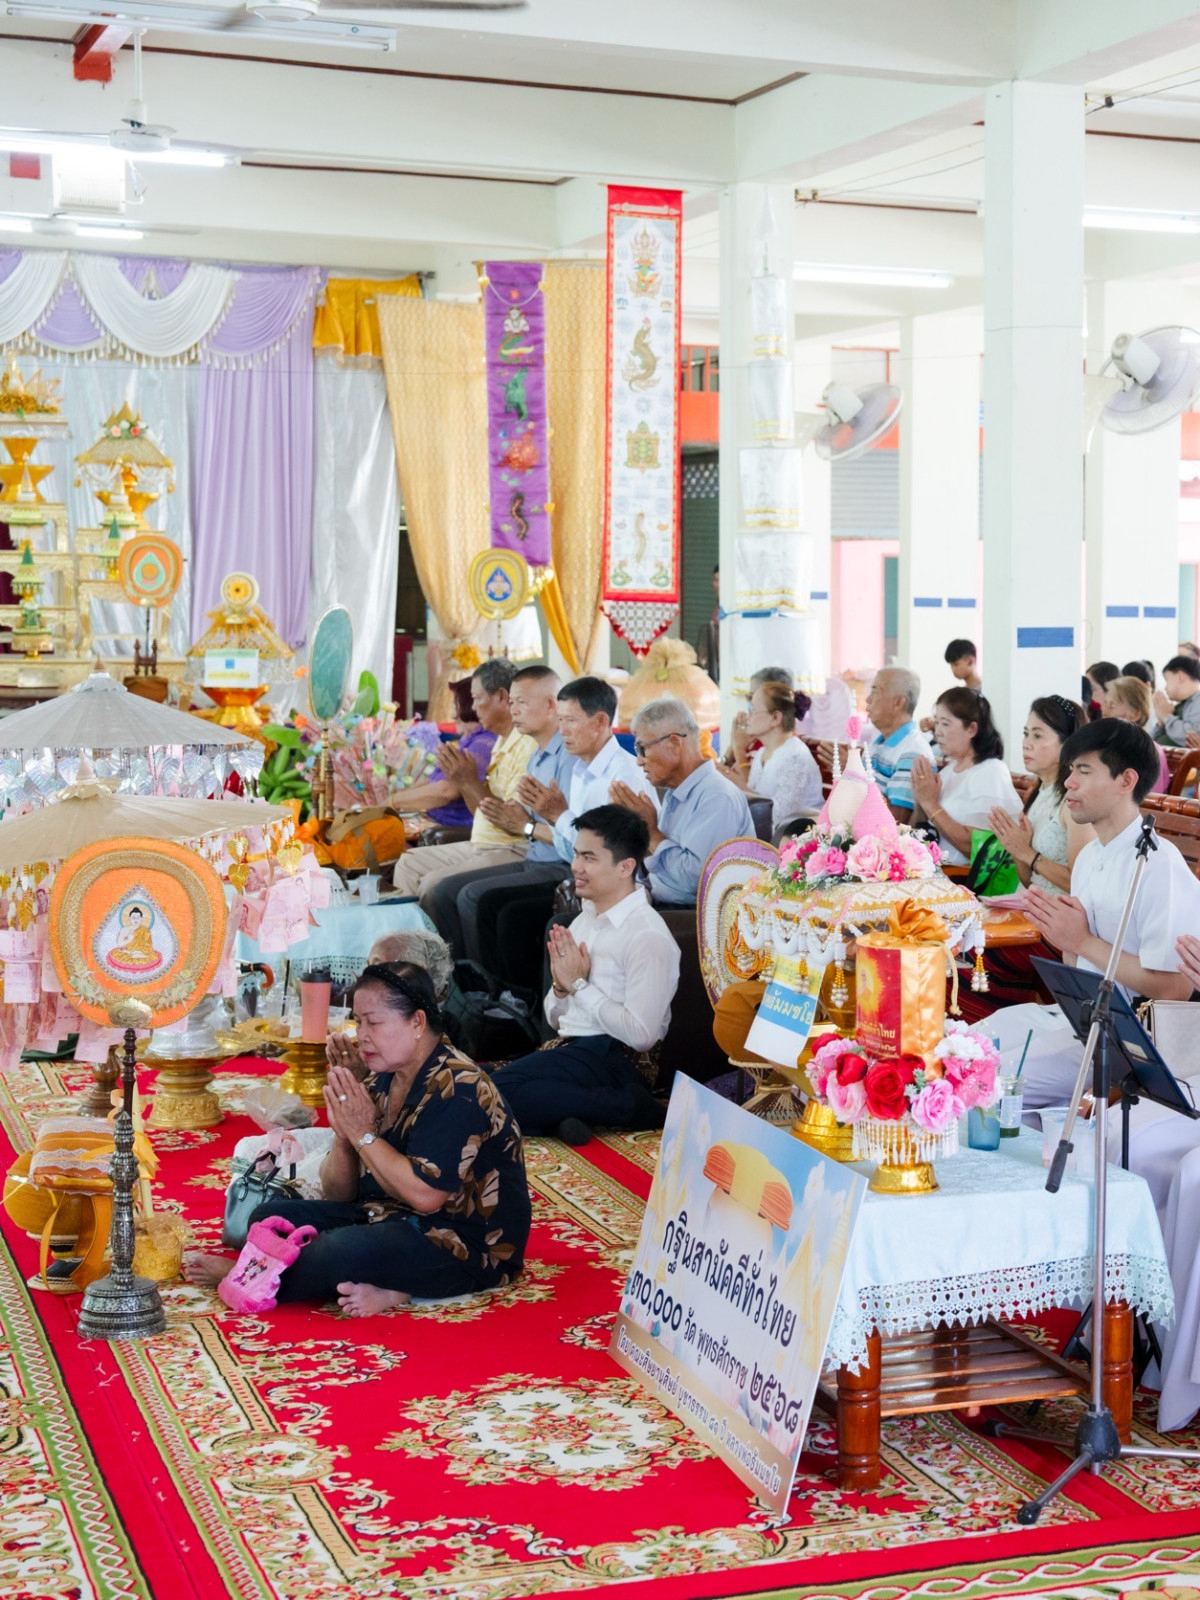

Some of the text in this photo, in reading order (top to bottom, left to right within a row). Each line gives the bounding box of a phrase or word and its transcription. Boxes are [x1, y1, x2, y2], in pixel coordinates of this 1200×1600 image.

[661, 1210, 797, 1348] กฐินสามัคคีทั่วไทย
[617, 1325, 630, 1354] โดย
[678, 1387, 709, 1424] บูชาธรรม
[630, 1270, 802, 1434] ๓๐,๐๐๐ วัด พุทธศักราช ๒๕๖๘
